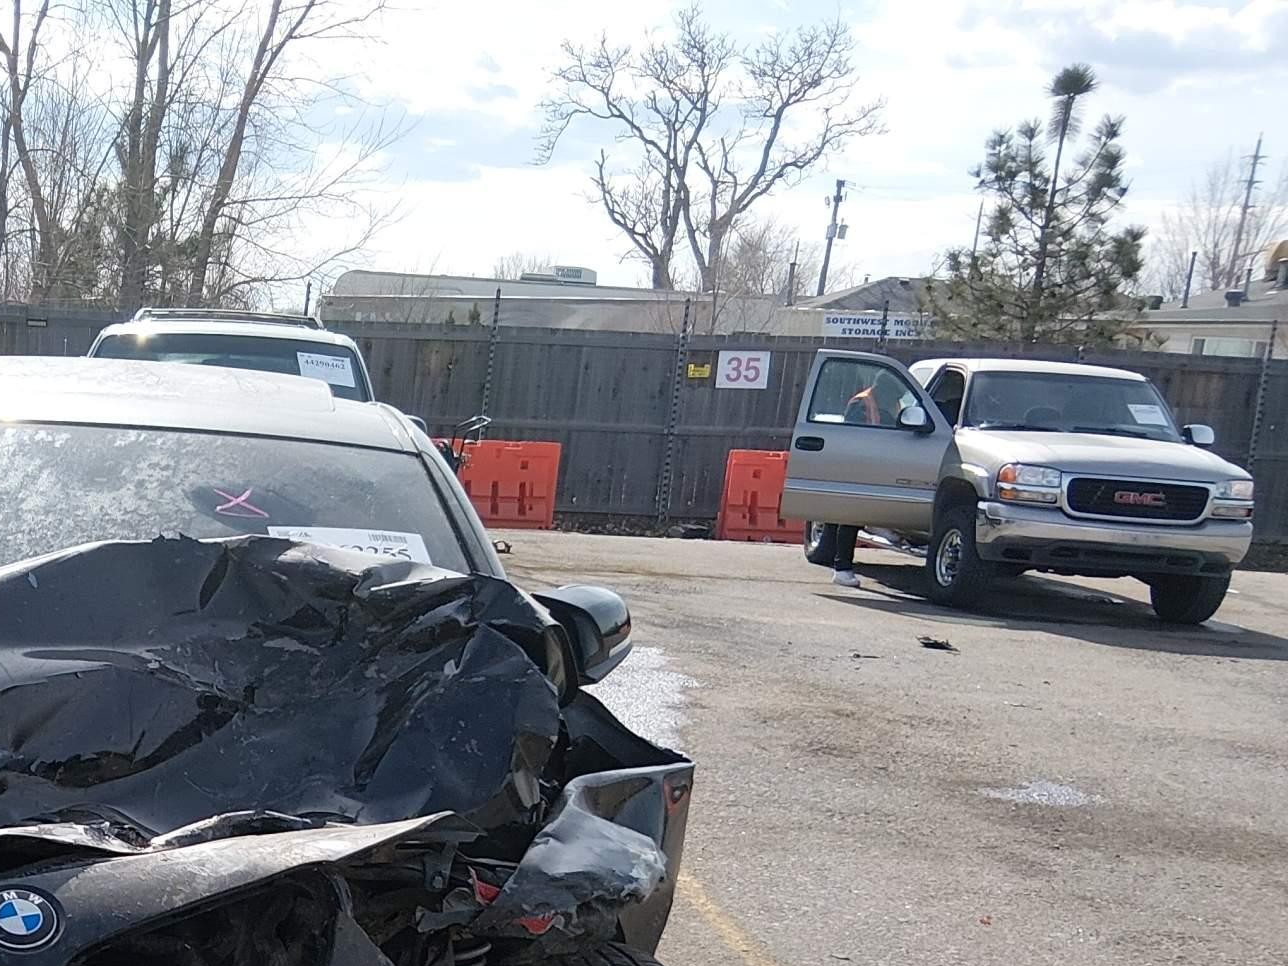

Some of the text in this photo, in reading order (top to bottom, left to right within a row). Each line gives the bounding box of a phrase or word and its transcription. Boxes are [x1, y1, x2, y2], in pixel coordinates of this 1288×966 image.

[825, 317, 890, 326] SOUTHWEST
[841, 328, 890, 336] STORAGE
[725, 357, 761, 382] 35
[1114, 491, 1166, 506] GMC
